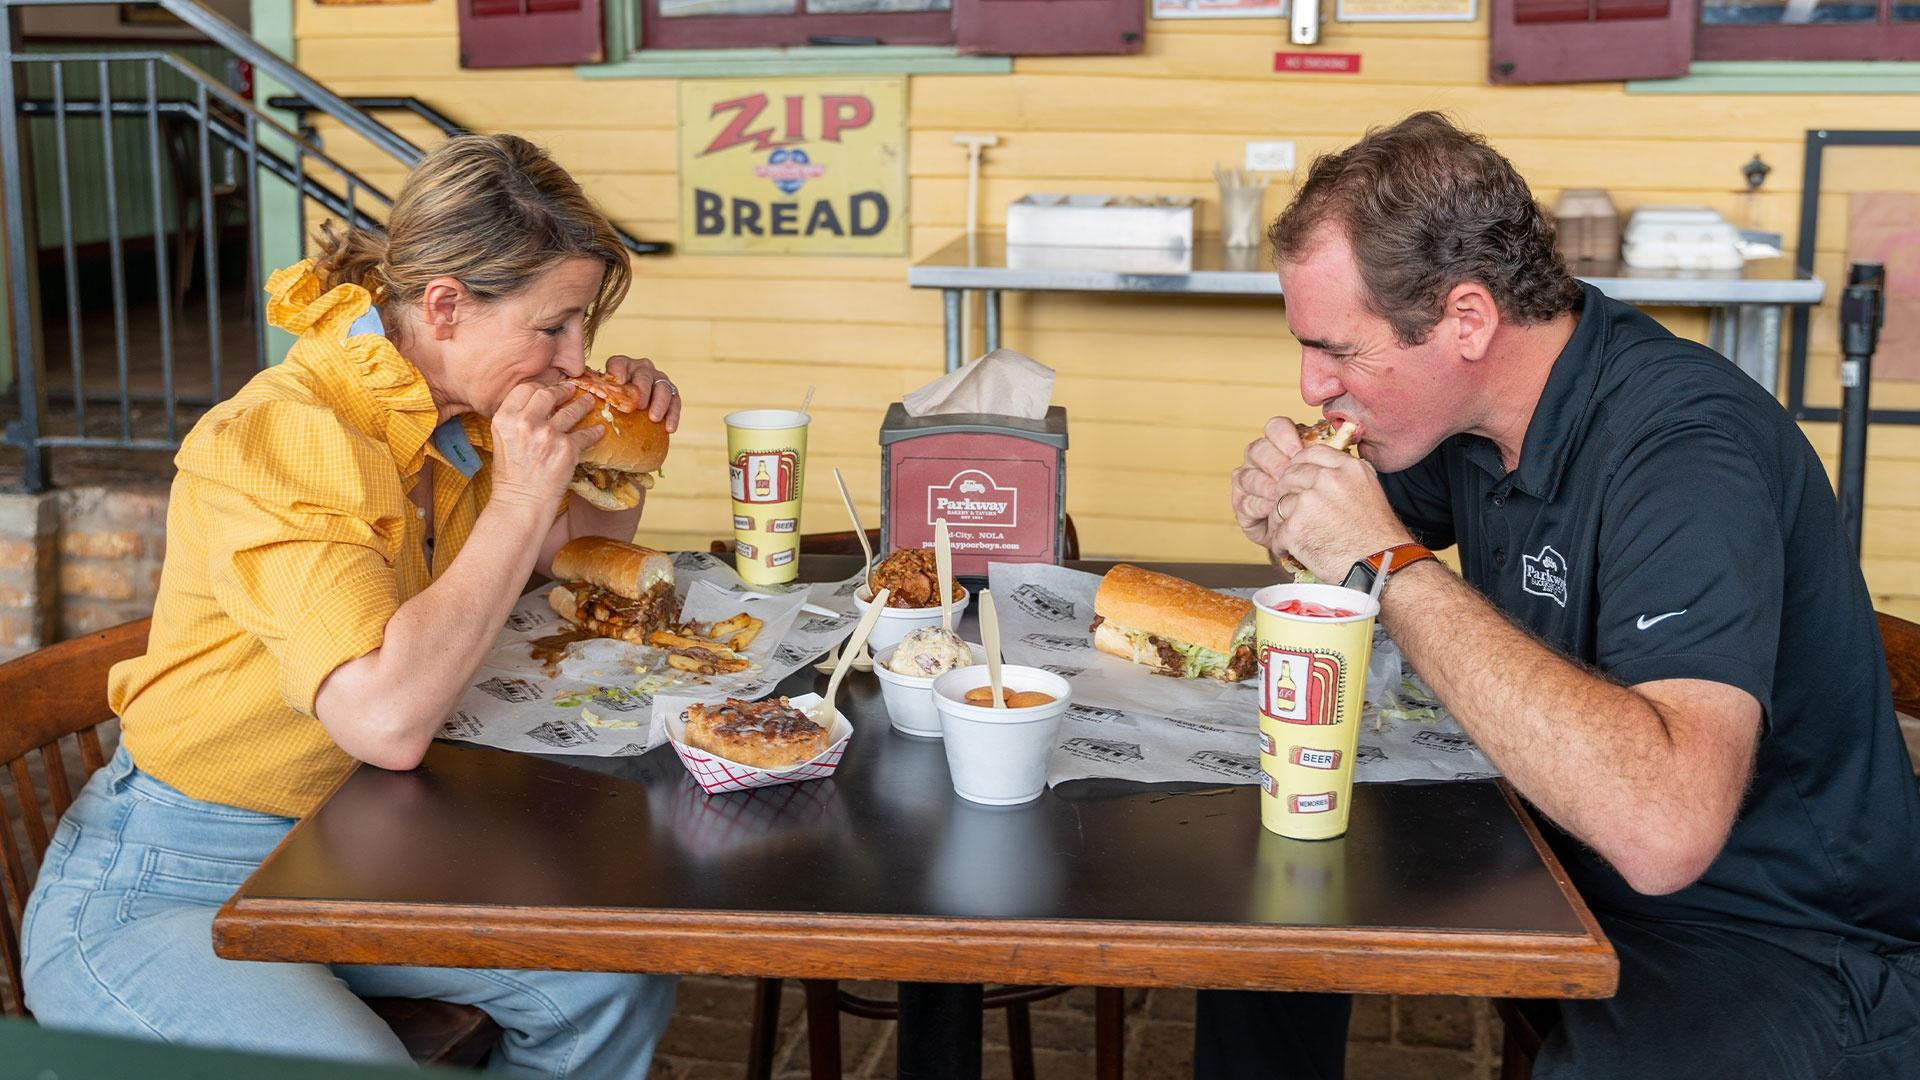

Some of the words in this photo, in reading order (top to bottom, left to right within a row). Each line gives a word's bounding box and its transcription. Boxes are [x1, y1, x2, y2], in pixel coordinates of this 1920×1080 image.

[694, 92, 874, 158] ZIP
[694, 188, 890, 237] BREAD
[937, 498, 1007, 513] Parkway
[776, 521, 794, 530] BEER
[922, 541, 1019, 551] paraypoorboys.com
[1303, 752, 1332, 764] BEER
